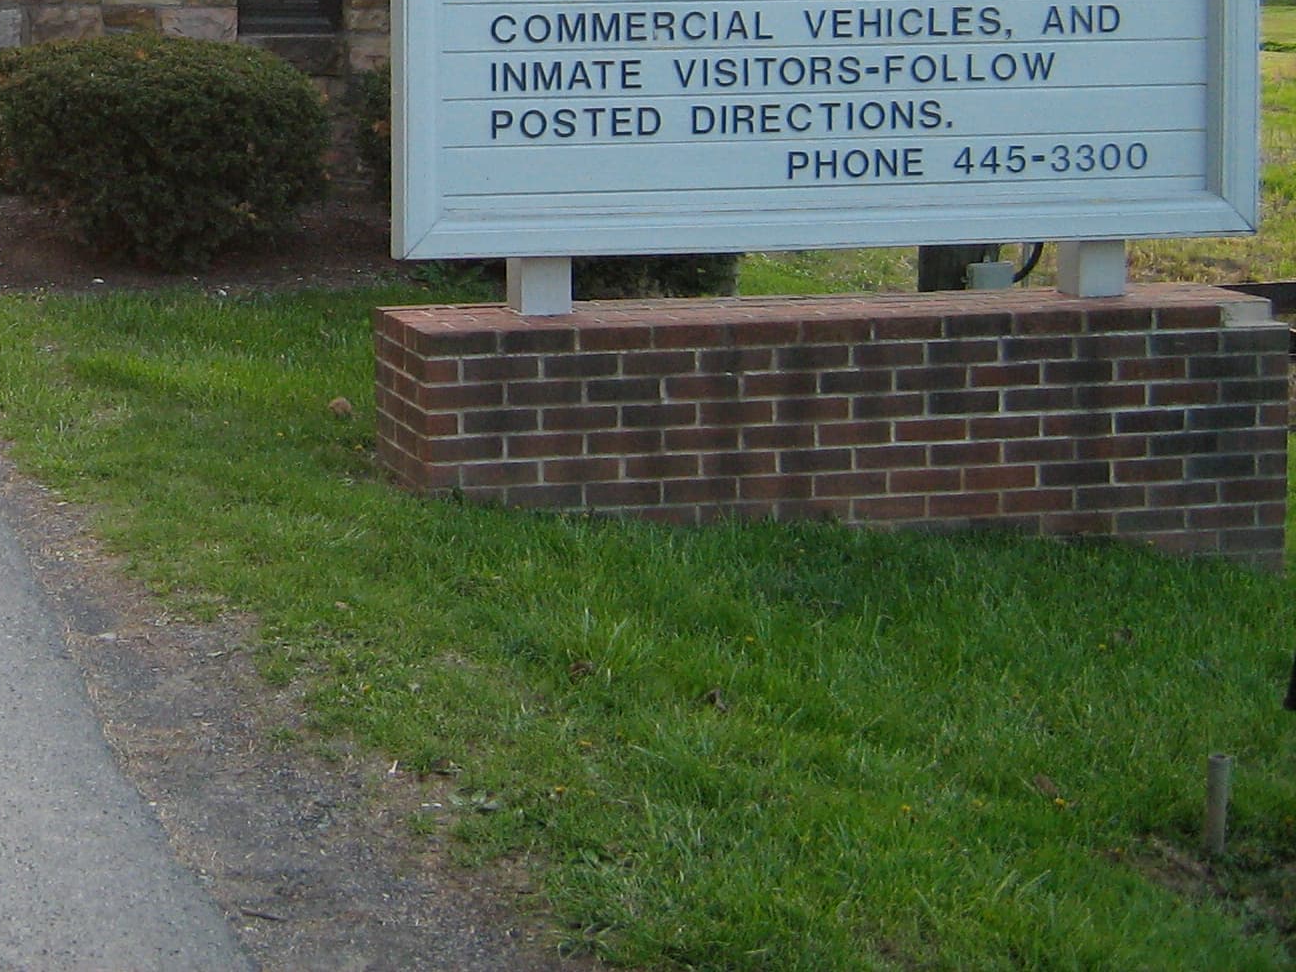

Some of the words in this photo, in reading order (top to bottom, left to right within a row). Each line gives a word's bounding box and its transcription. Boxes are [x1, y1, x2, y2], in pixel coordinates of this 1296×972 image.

[490, 12, 773, 44] COMMERCIAL
[804, 7, 1012, 40] VEHICLES,
[1042, 5, 1120, 34] AND
[491, 61, 642, 92] INMATE
[673, 52, 1055, 87] VISITORS-FOLLOW
[491, 108, 661, 140] POSTED
[691, 101, 952, 135] DIRECTIONS.
[788, 148, 923, 179] PHONE
[954, 143, 1147, 174] 445-3300
